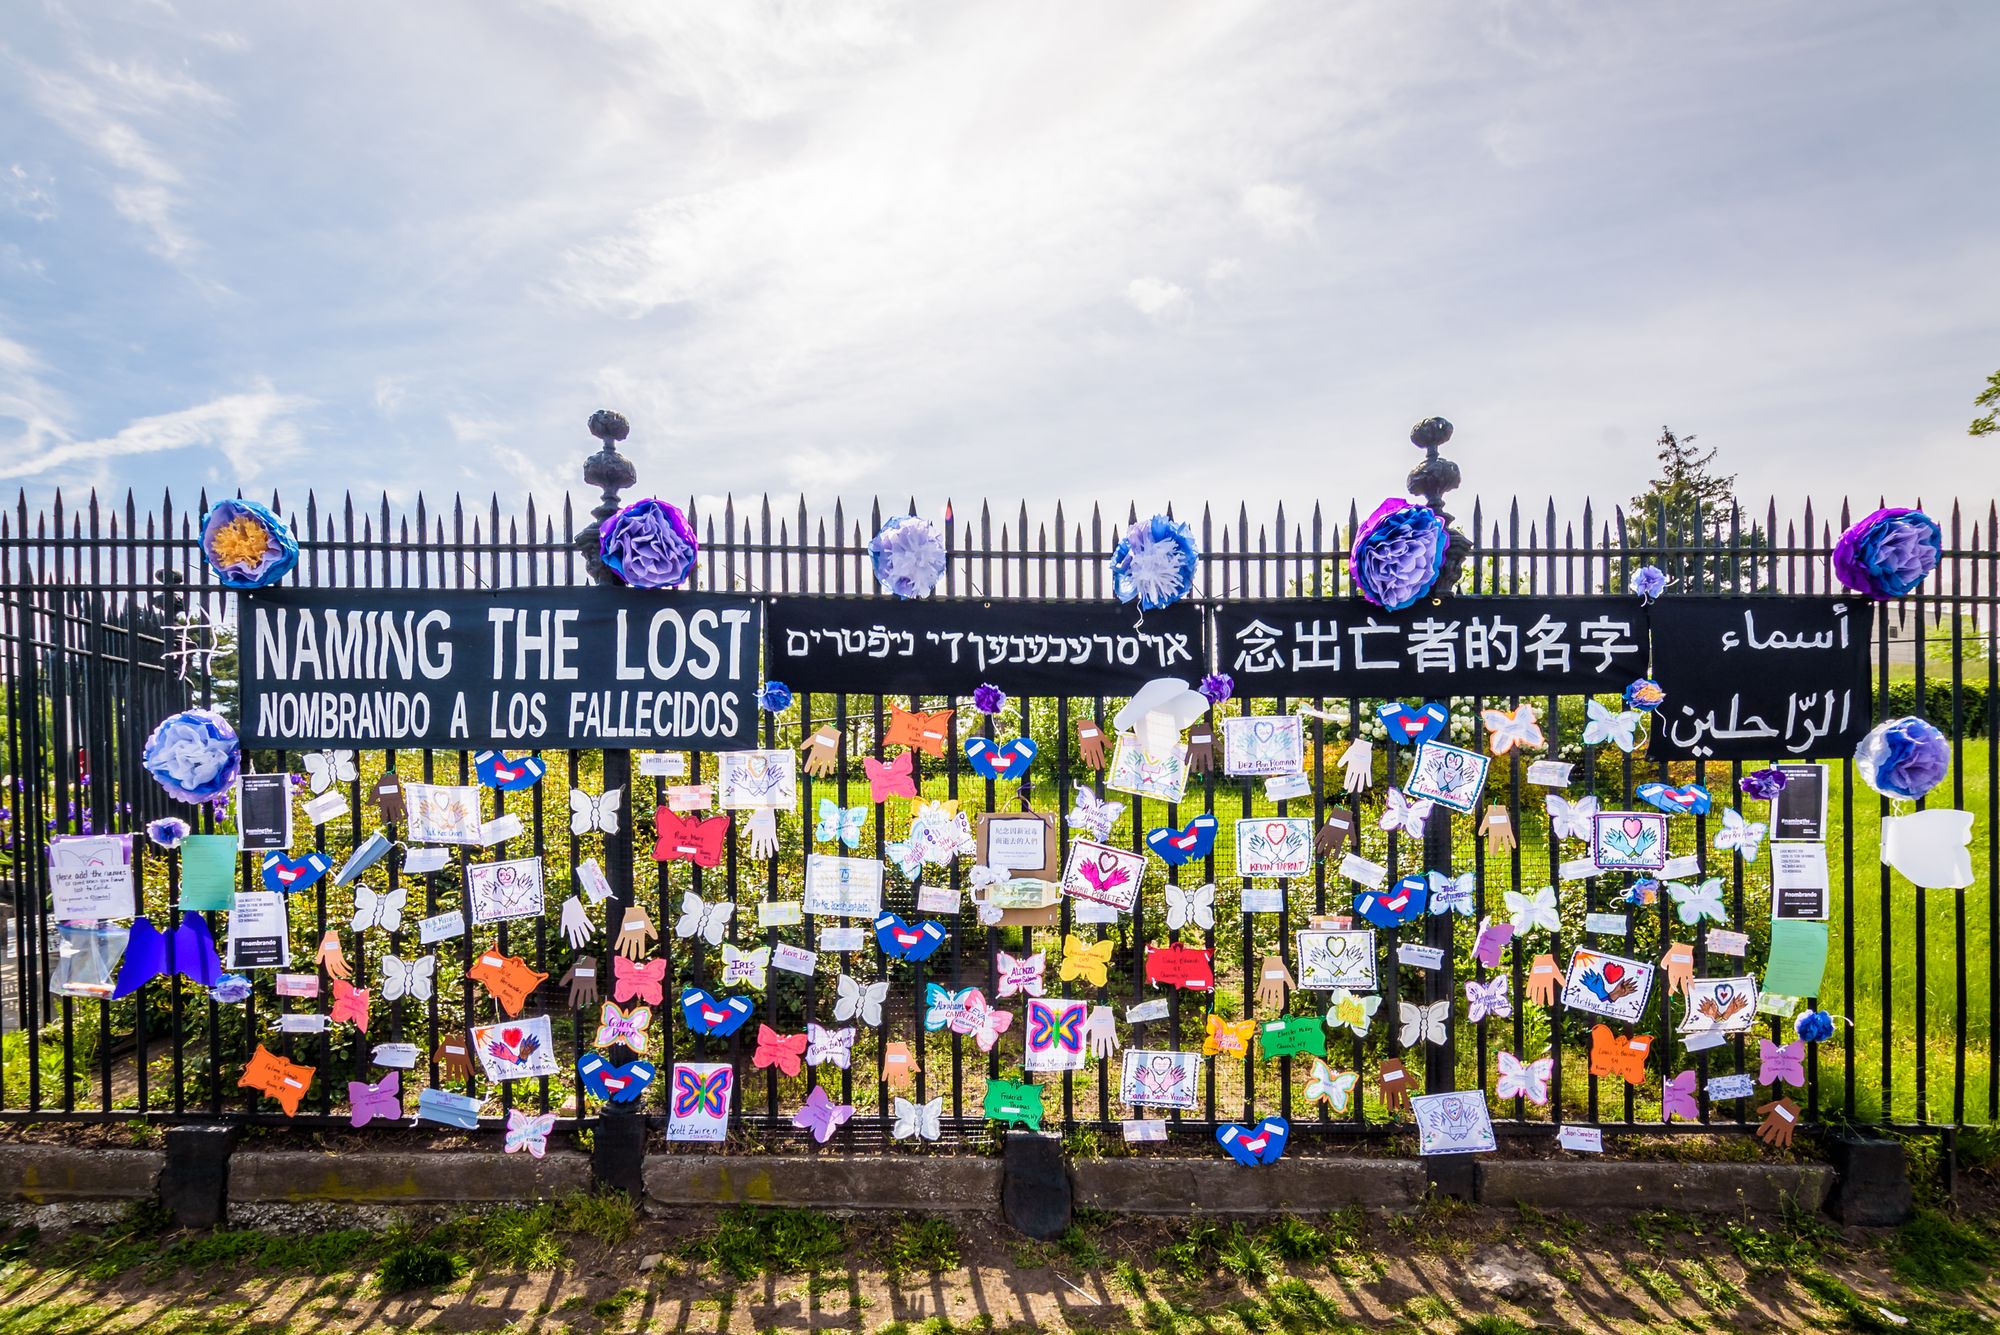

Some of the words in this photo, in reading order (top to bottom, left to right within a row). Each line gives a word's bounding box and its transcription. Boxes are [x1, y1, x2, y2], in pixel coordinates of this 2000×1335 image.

[256, 608, 453, 681] NAMING
[487, 606, 580, 681] THE
[615, 608, 751, 681] LOST
[1233, 614, 1639, 674] 念出亡者的名字
[1722, 603, 1849, 651] أسماء
[257, 691, 430, 739] NOMBRANDO
[450, 691, 469, 738] A
[490, 691, 547, 739] LOS
[568, 690, 739, 739] FALLECIDOS
[731, 960, 756, 970] IRIS
[1011, 966, 1036, 976] ALONZO
[669, 1124, 686, 1134] Scott
